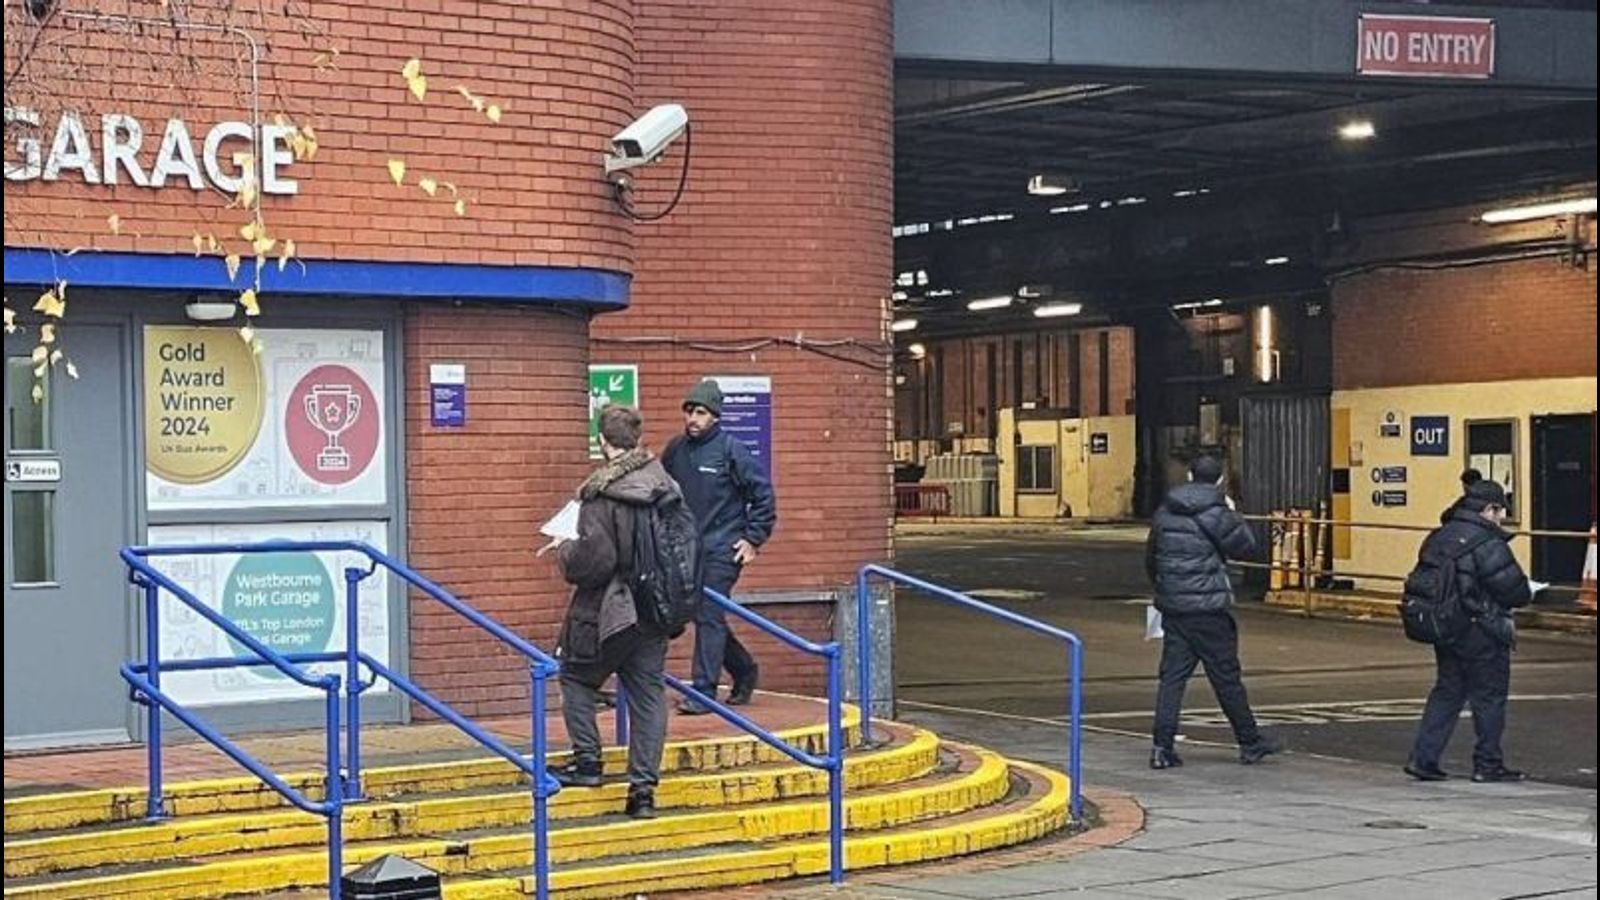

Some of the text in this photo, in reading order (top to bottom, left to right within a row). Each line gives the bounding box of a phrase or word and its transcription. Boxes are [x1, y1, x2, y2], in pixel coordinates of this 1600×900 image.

[1365, 30, 1486, 64] NO ENTRY
[4, 106, 298, 194] GARAGE
[159, 343, 206, 362] Gold
[159, 367, 225, 386] Award
[160, 392, 235, 412] Winner
[160, 417, 210, 436] 2024
[1415, 427, 1445, 445] OUT
[236, 573, 322, 589] Westbourne
[235, 591, 320, 608] Park Garage
[262, 619, 281, 632] Top
[283, 616, 324, 628] London
[272, 633, 311, 646] Garage
